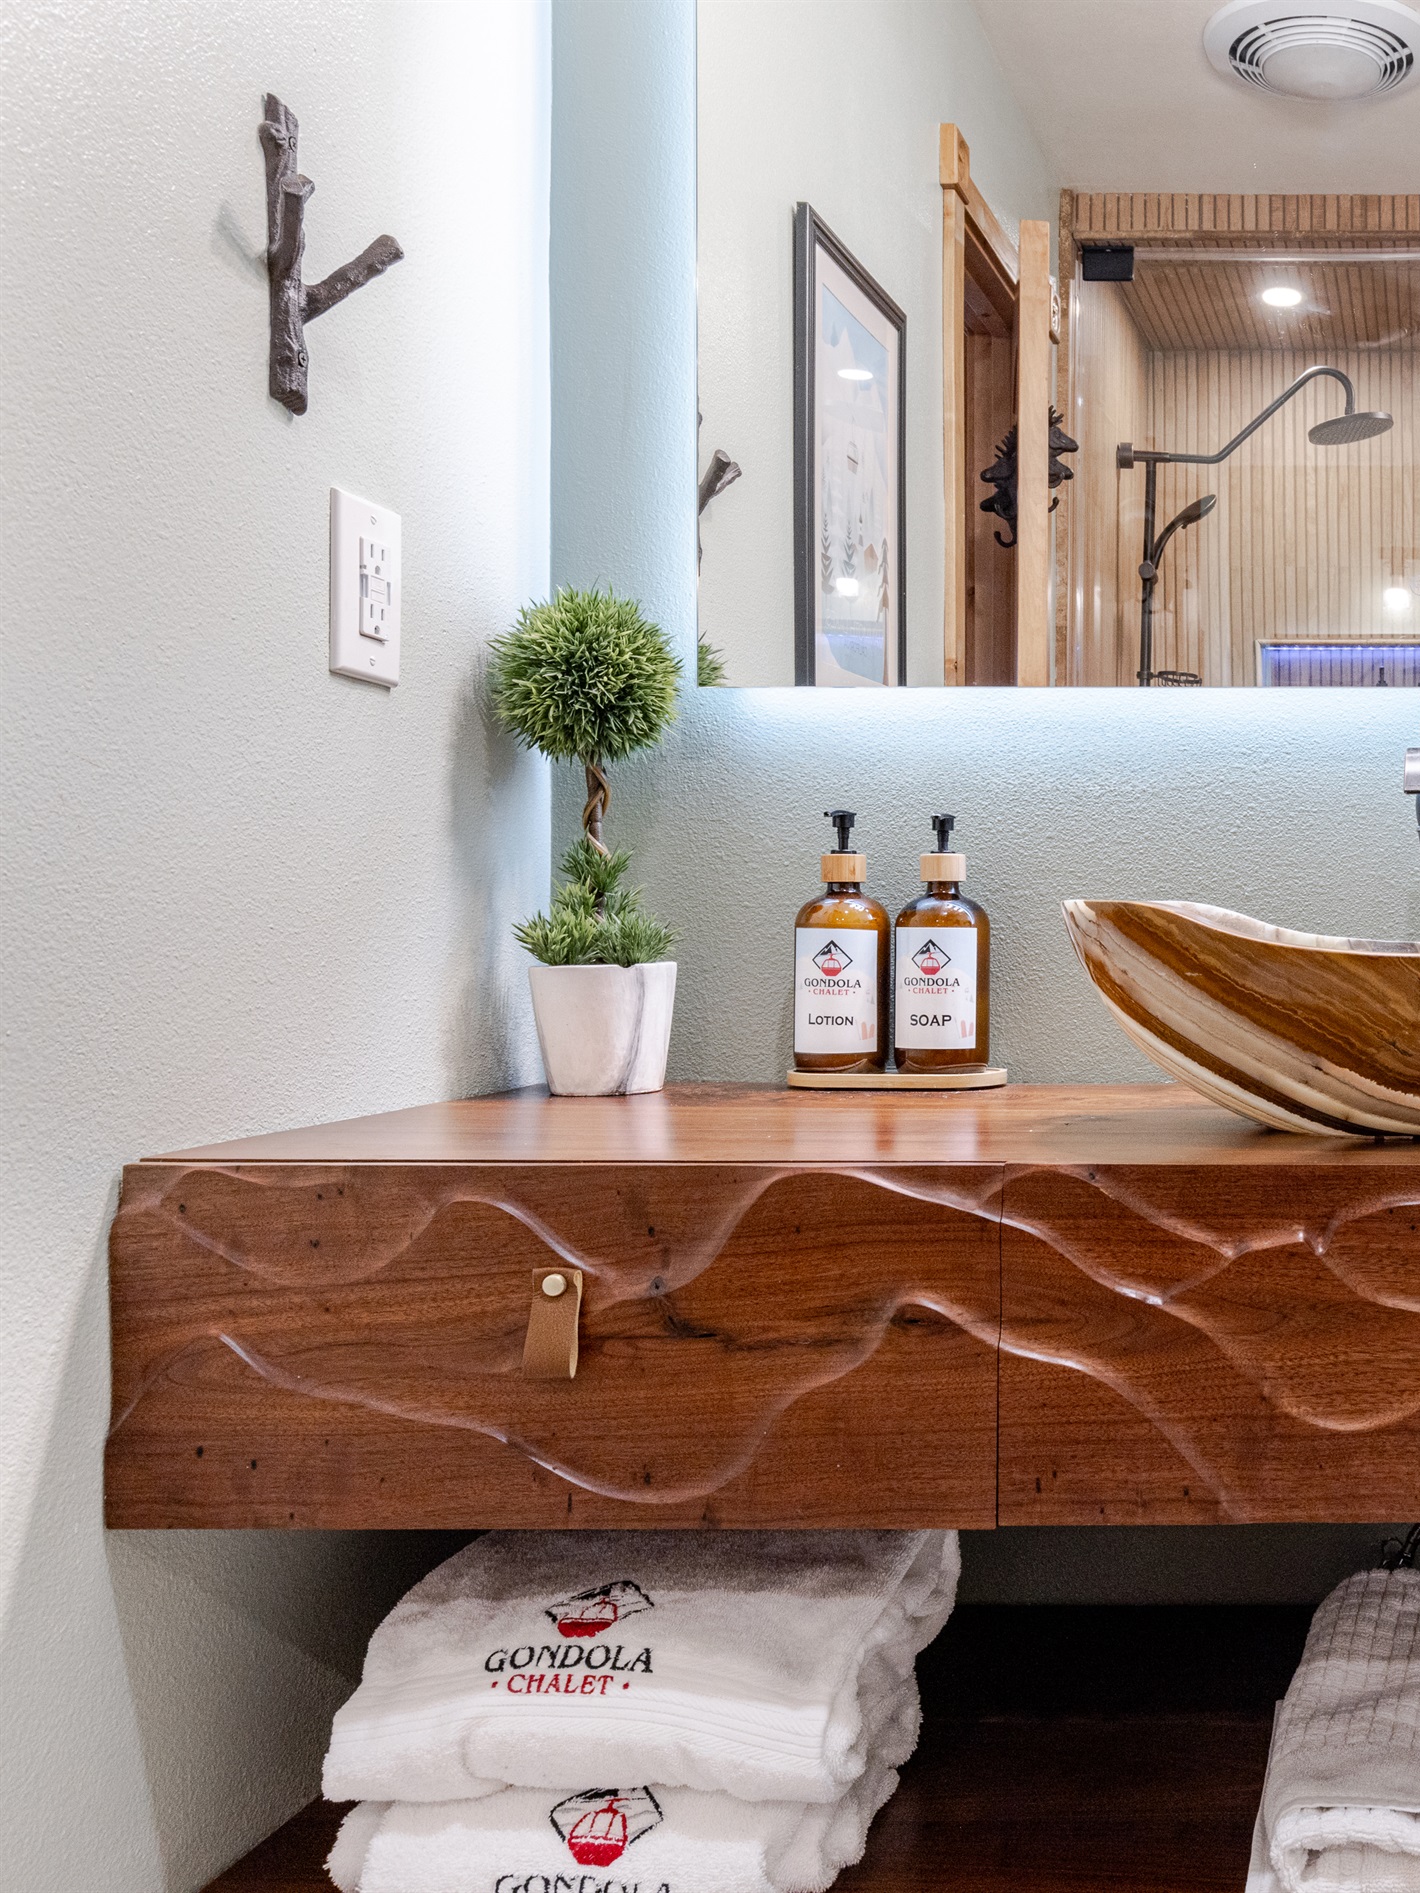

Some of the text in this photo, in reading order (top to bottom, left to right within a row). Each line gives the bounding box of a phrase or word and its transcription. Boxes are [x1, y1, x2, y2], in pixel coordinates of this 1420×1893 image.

[804, 977, 862, 988] GONDOLA
[903, 976, 960, 987] GONDOLA
[813, 988, 850, 996] CHALET
[912, 987, 949, 995] CHALET
[910, 1014, 952, 1027] SOAP
[484, 1644, 653, 1674] GONDOLA
[507, 1673, 614, 1695] CHALET
